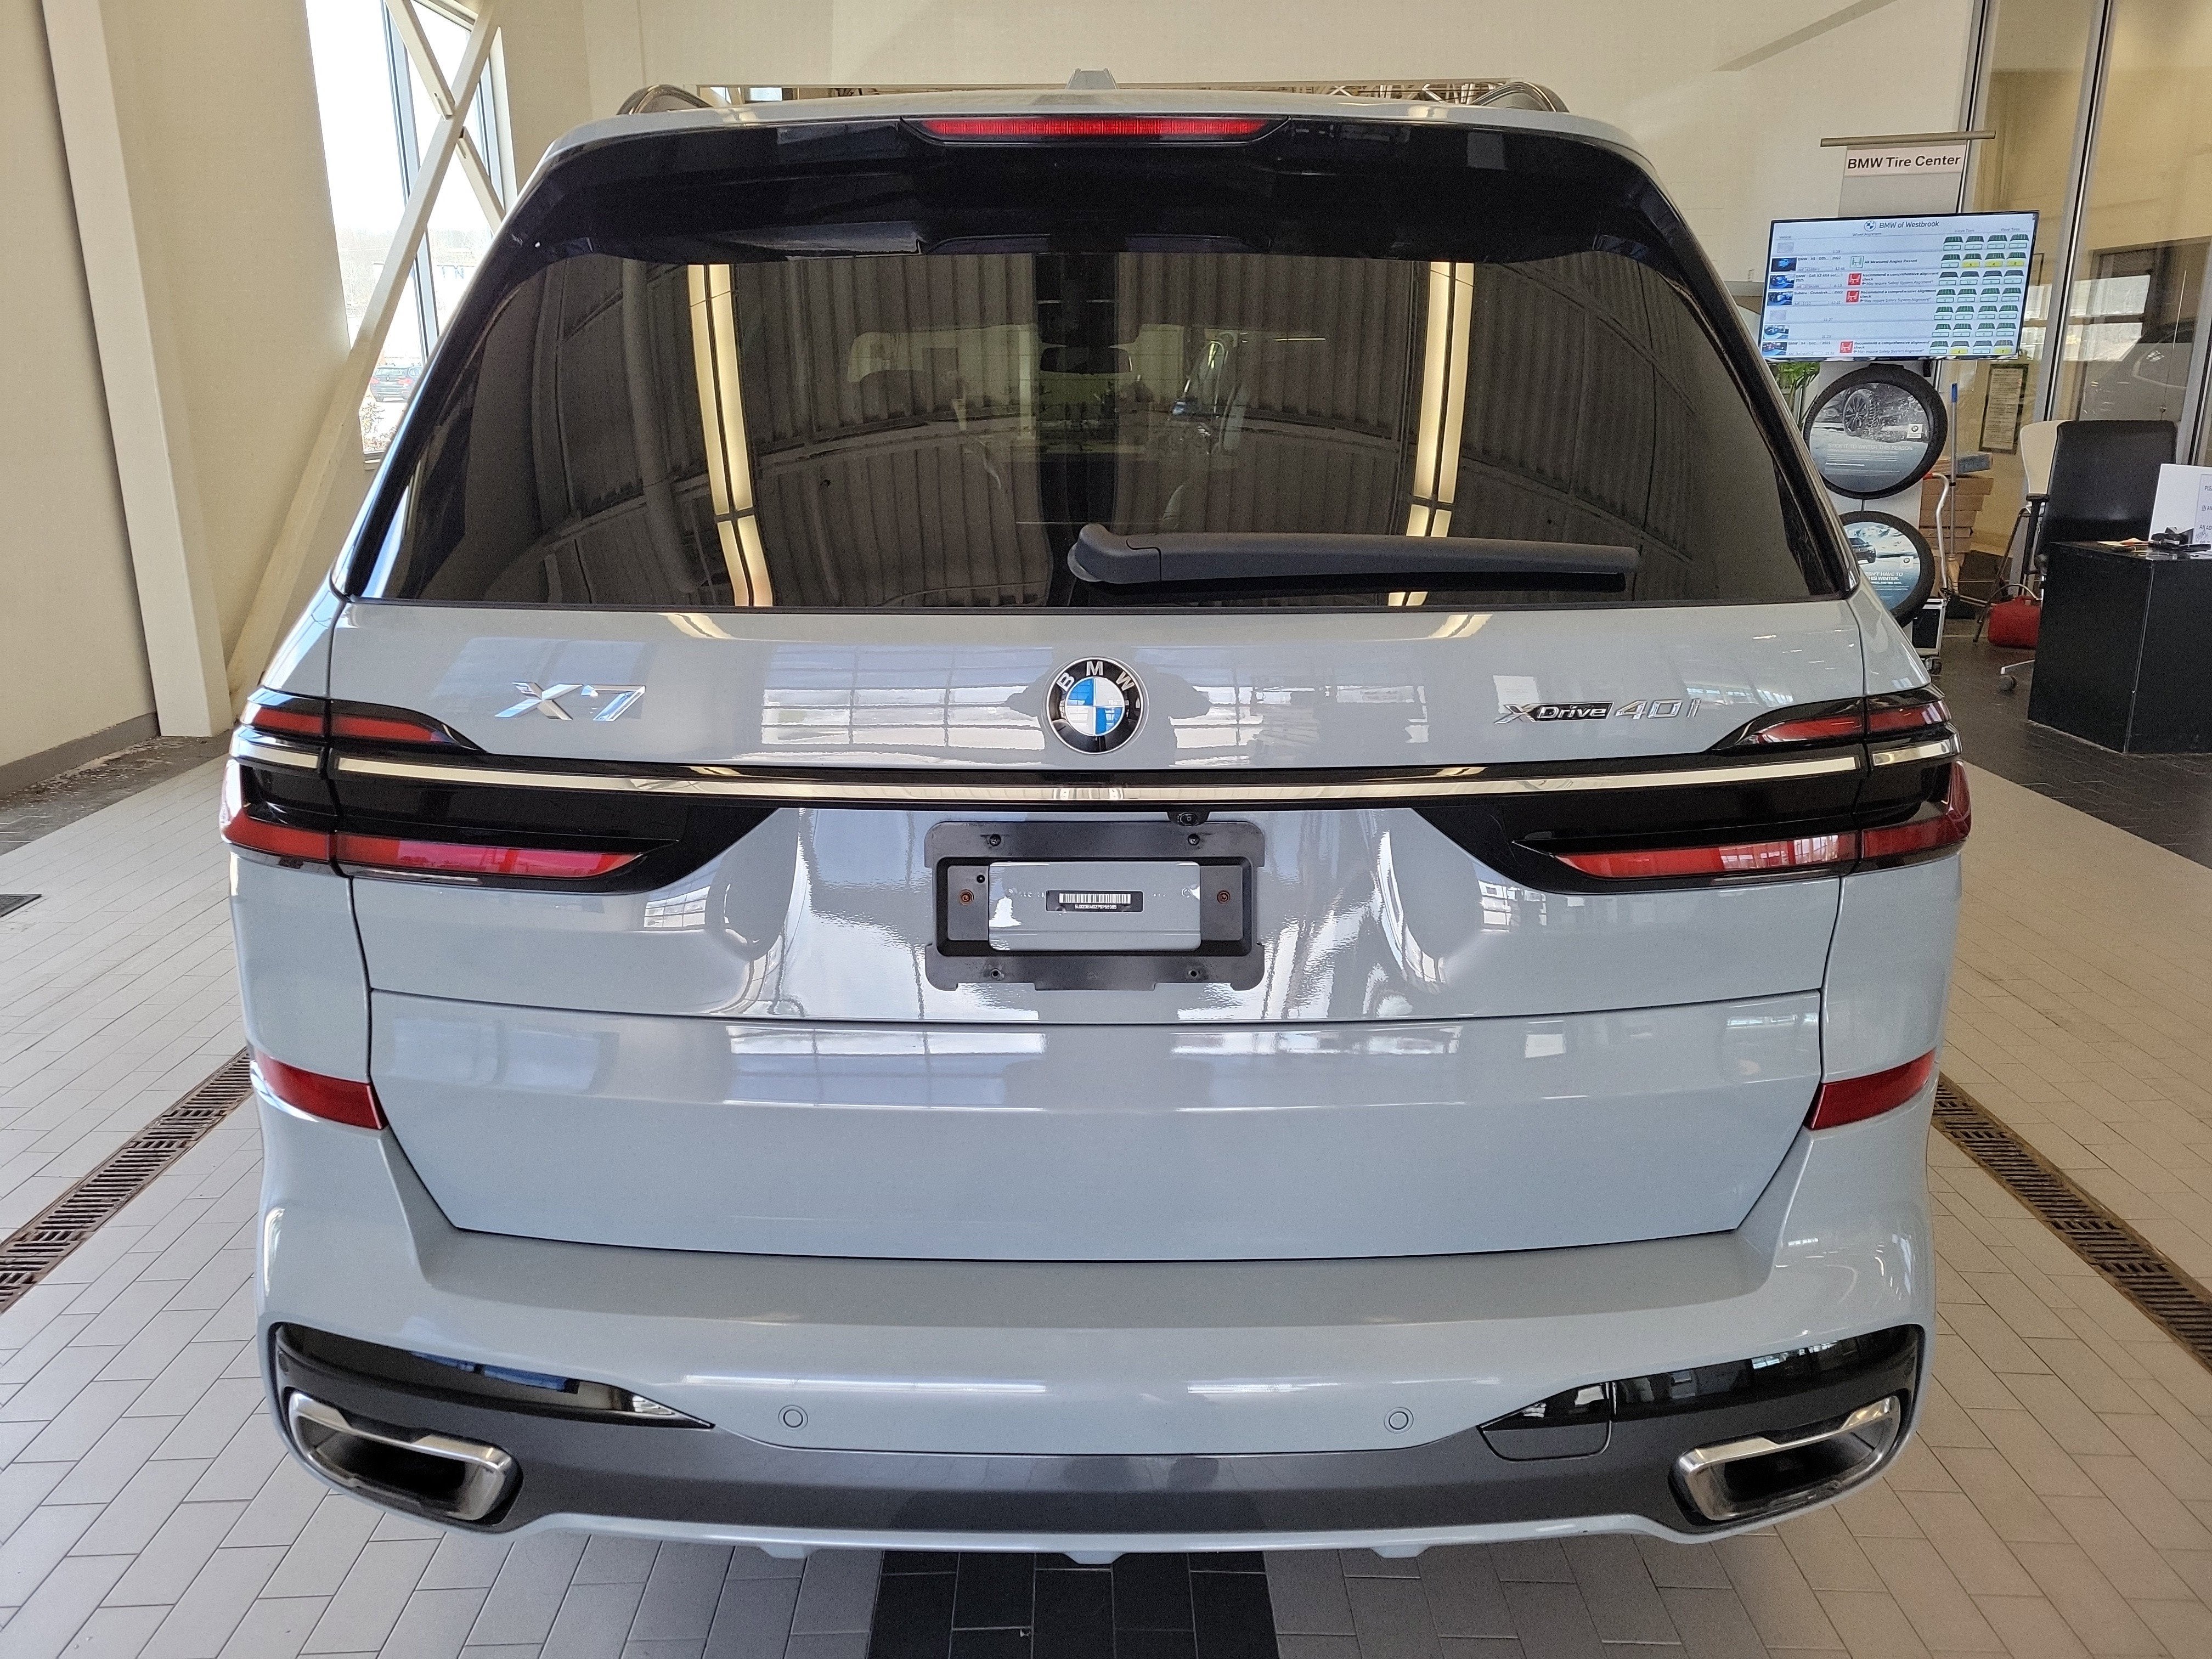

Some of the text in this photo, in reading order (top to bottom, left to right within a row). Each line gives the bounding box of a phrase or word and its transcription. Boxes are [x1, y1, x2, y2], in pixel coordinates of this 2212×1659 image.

[1847, 155, 1961, 169] BMW Tire Center
[1056, 661, 1135, 692] BMW
[494, 682, 647, 721] X7
